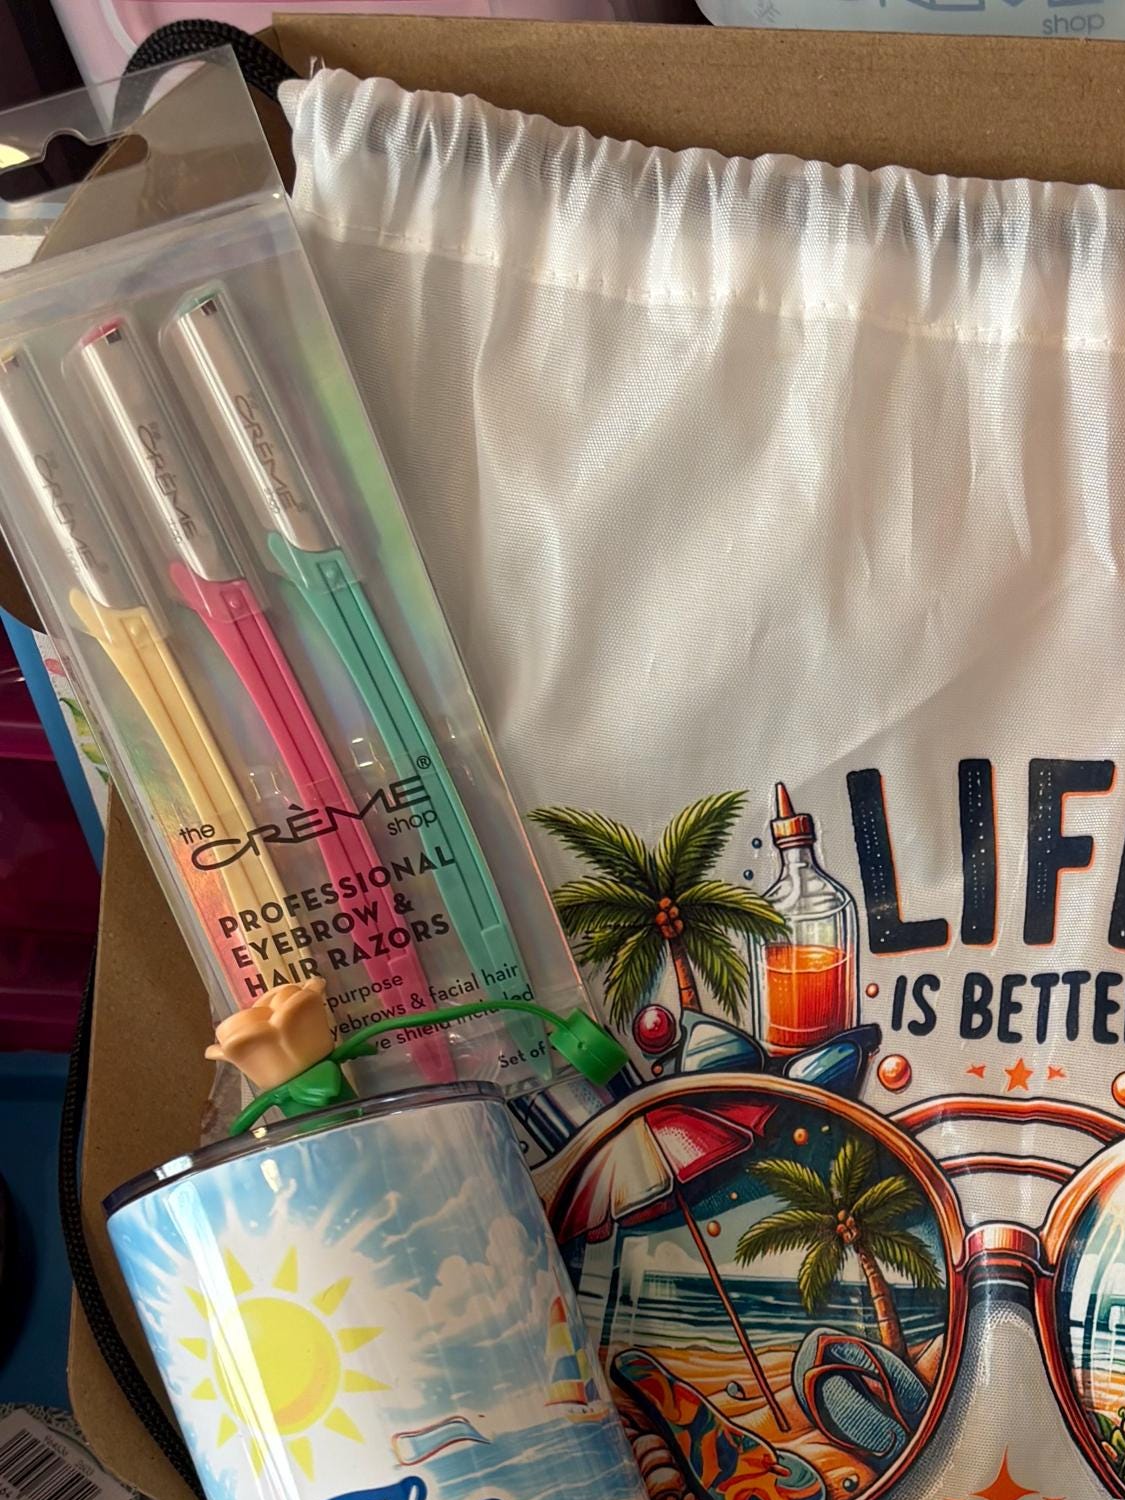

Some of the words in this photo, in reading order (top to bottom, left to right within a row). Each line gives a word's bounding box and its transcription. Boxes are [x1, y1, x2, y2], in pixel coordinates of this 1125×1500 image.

[1042, 13, 1105, 36] shop
[179, 824, 216, 846] the
[191, 776, 432, 871] CRÈME
[387, 809, 438, 836] shop
[218, 846, 456, 938] PROFESSIONAL
[231, 902, 380, 968] EYEBROW
[393, 893, 416, 915] &
[245, 956, 326, 998] HAIR
[327, 914, 451, 970] RAZORS
[328, 1002, 407, 1040] yebrows
[410, 992, 427, 1010] &
[429, 974, 480, 1004] facial
[481, 963, 521, 987] hair
[891, 974, 941, 1037] IS
[498, 1049, 527, 1069] Set
[530, 1041, 547, 1059] of
